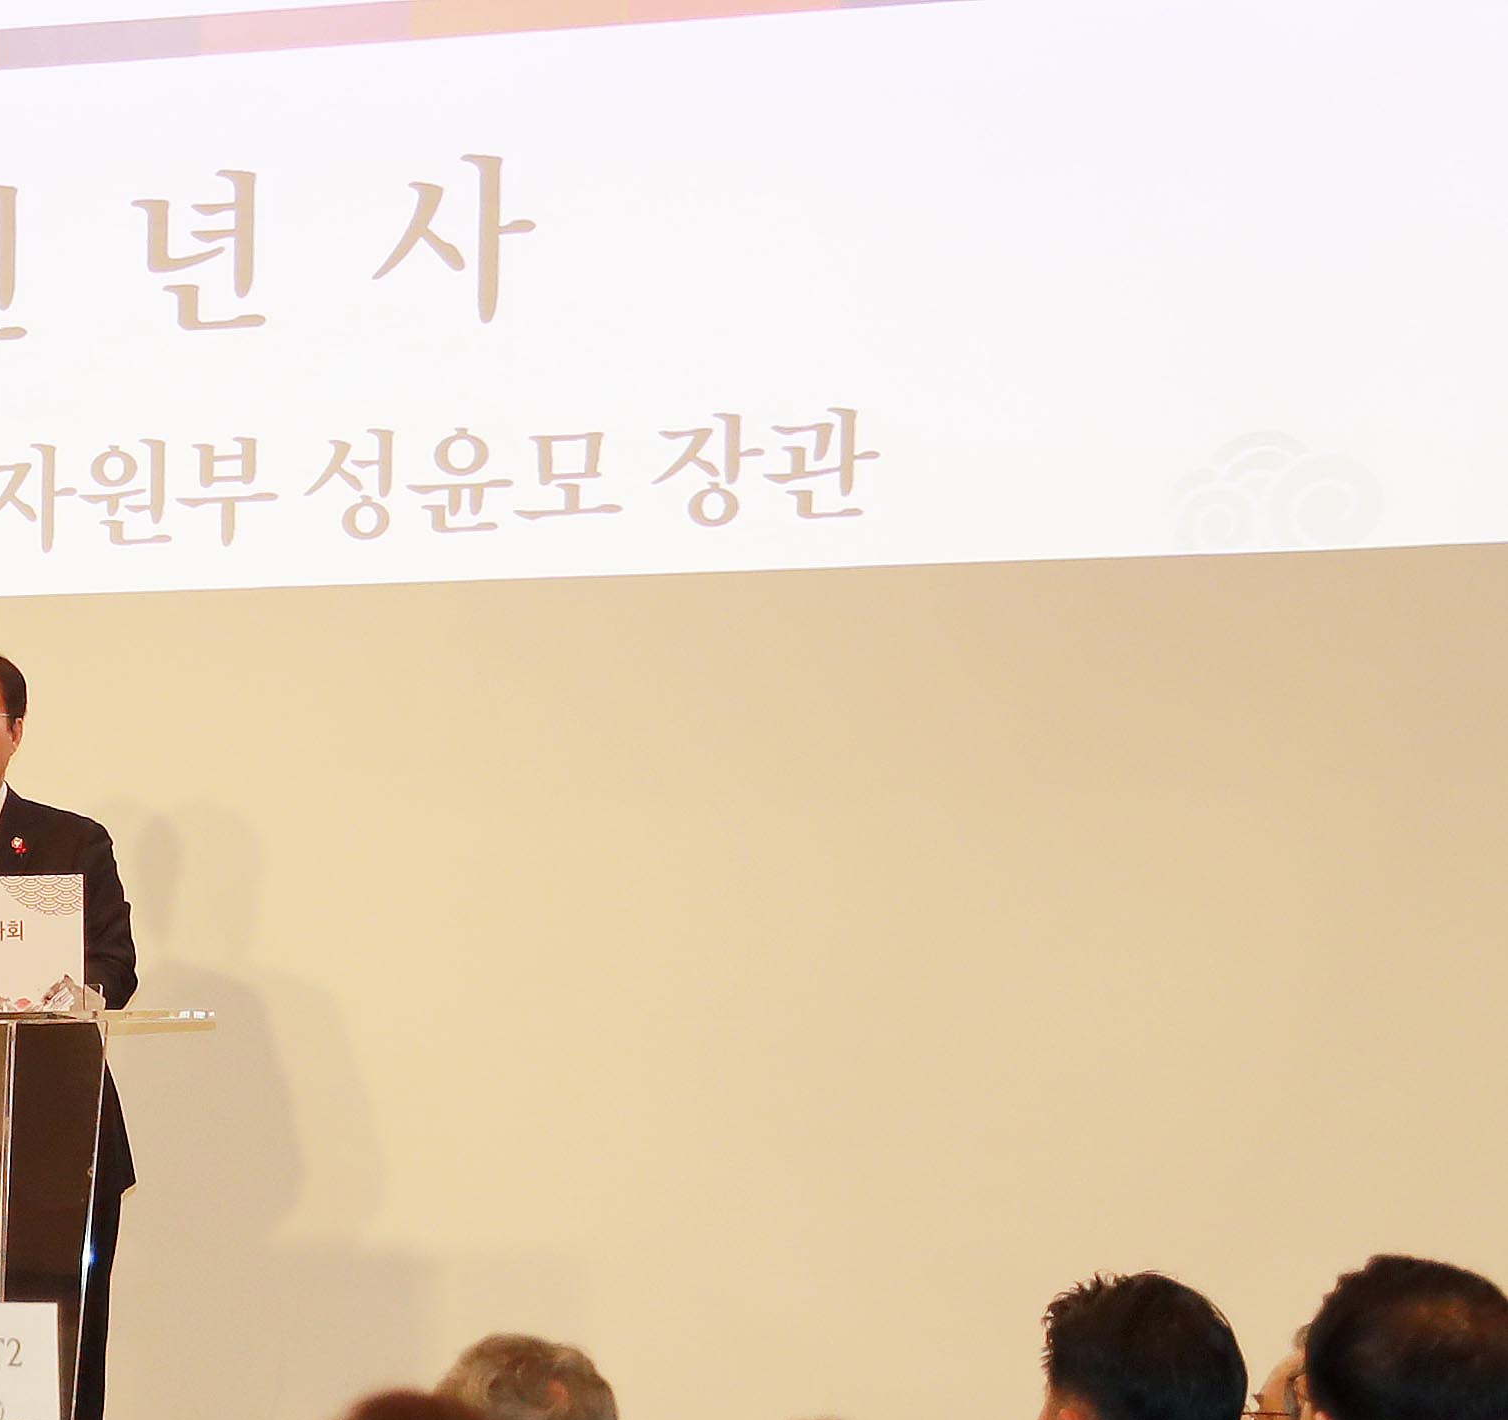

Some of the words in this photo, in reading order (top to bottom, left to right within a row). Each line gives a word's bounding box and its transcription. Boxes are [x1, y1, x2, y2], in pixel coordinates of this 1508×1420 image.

[131, 170, 266, 330] 년
[372, 154, 536, 323] 사
[305, 428, 622, 539] 성윤모
[652, 408, 880, 527] 장관
